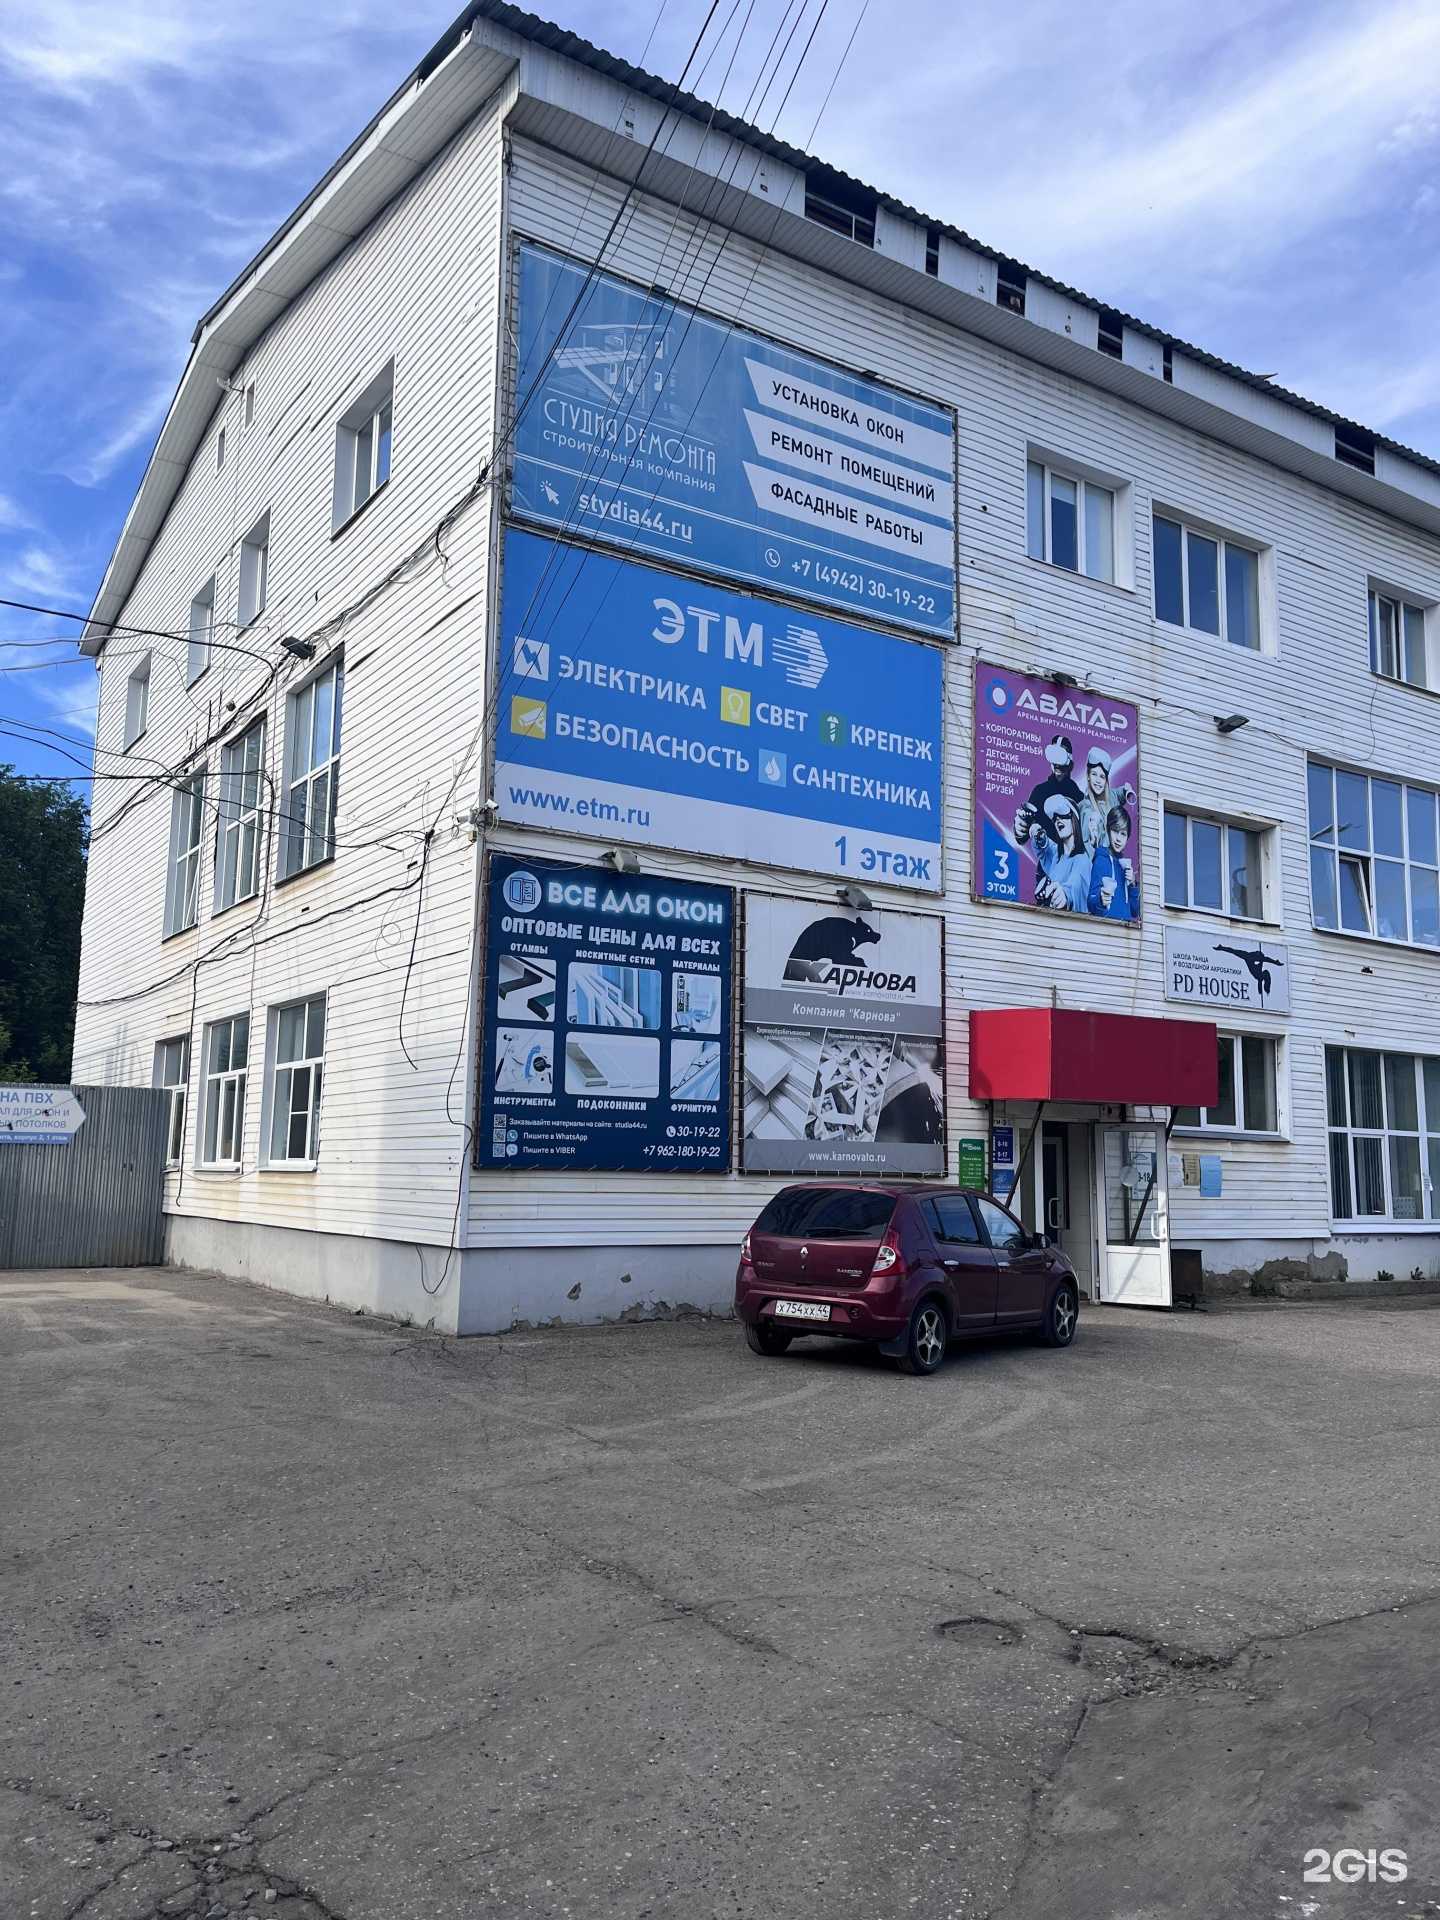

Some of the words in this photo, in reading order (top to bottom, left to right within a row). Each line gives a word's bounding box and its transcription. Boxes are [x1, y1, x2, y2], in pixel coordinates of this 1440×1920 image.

[772, 380, 860, 428] УСТАНОВКА
[866, 418, 905, 444] ОКОН
[625, 423, 716, 476] РЕМОНТА
[543, 429, 643, 470] строительная
[648, 461, 716, 493] компания
[771, 431, 833, 466] РЕМОНТ
[841, 456, 936, 502] ПОМЕЩЕНИЙ
[578, 494, 692, 541] stydia44.ru
[771, 482, 859, 524] ФАСАДНЫЕ
[866, 513, 923, 545] РАБОТЫ
[791, 559, 811, 577] +7
[815, 562, 864, 594] (4942)
[868, 579, 936, 614] 30-19-22
[652, 597, 765, 668] ЭТМ
[558, 654, 708, 711] ЭЛЕКТРИКА
[755, 701, 809, 733] СВЕТ
[850, 723, 934, 762] КРЕПЕЖ
[1016, 688, 1128, 732] АВАТАР
[986, 722, 1041, 743] КОРПОРАТИВЫ
[1017, 711, 1038, 721] АРЕНА
[1040, 716, 1086, 733] ВИРТУАЛЬНОЙ
[1087, 728, 1127, 744] РЕАЛЬНОСТИ
[985, 735, 1013, 749] ОТДЫХ
[1014, 742, 1043, 756] СЕМЬЕЙ
[985, 748, 1020, 763] ДЕТСКИЕ
[554, 711, 750, 774] БЕЗОПАСНОСТЬ
[792, 763, 932, 812] САНТЕХНИКА
[985, 759, 1030, 776] ПРАЗДНИКИ
[985, 771, 1019, 786] ВСТРЕЧИ
[985, 782, 1014, 796] ДРУЗЕЙ
[508, 783, 651, 828] www.etm.ru
[834, 836, 848, 867] 1
[859, 846, 931, 881] этаж
[993, 850, 1010, 880] 3
[986, 881, 1016, 896] этаж
[548, 881, 597, 908] ВСЕ
[601, 889, 650, 915] ДЛЯ
[656, 896, 724, 924] ОКОН
[501, 916, 583, 940] ОПТОВЫЕ
[588, 926, 637, 946] ЦЕНЫ
[641, 932, 677, 951] ДЛЯ
[681, 938, 721, 956] ВСЕХ
[510, 942, 548, 955] ОТЛИВЫ
[575, 949, 627, 963] МОСКИТНЫЕ
[629, 954, 656, 966] СЕТКИ
[672, 959, 721, 972] МАТЕРИАЛЫ
[1177, 961, 1209, 971] ВОЗДУШНОЙ
[1210, 966, 1242, 975] АКРОБАТИКИ
[1173, 973, 1194, 993] PD
[1199, 976, 1250, 1000] HOUSE
[792, 1002, 846, 1018] Компания
[850, 1007, 901, 1023] "Карнова"
[24, 1092, 54, 1104] ПВХ
[493, 1096, 556, 1107] ИНСТРУМЕНТЫ
[577, 1099, 647, 1111] ПОДОКОННИКИ
[671, 1103, 718, 1113] ФУРНИТУРА
[523, 1132, 549, 1140] Пишите
[555, 1132, 588, 1142] WhatsApp
[677, 1125, 721, 1139] 30-19-22
[523, 1146, 549, 1154] Пишите
[555, 1146, 576, 1154] VIBER
[643, 1146, 656, 1156] +7
[657, 1145, 721, 1157] 962-180-19-22
